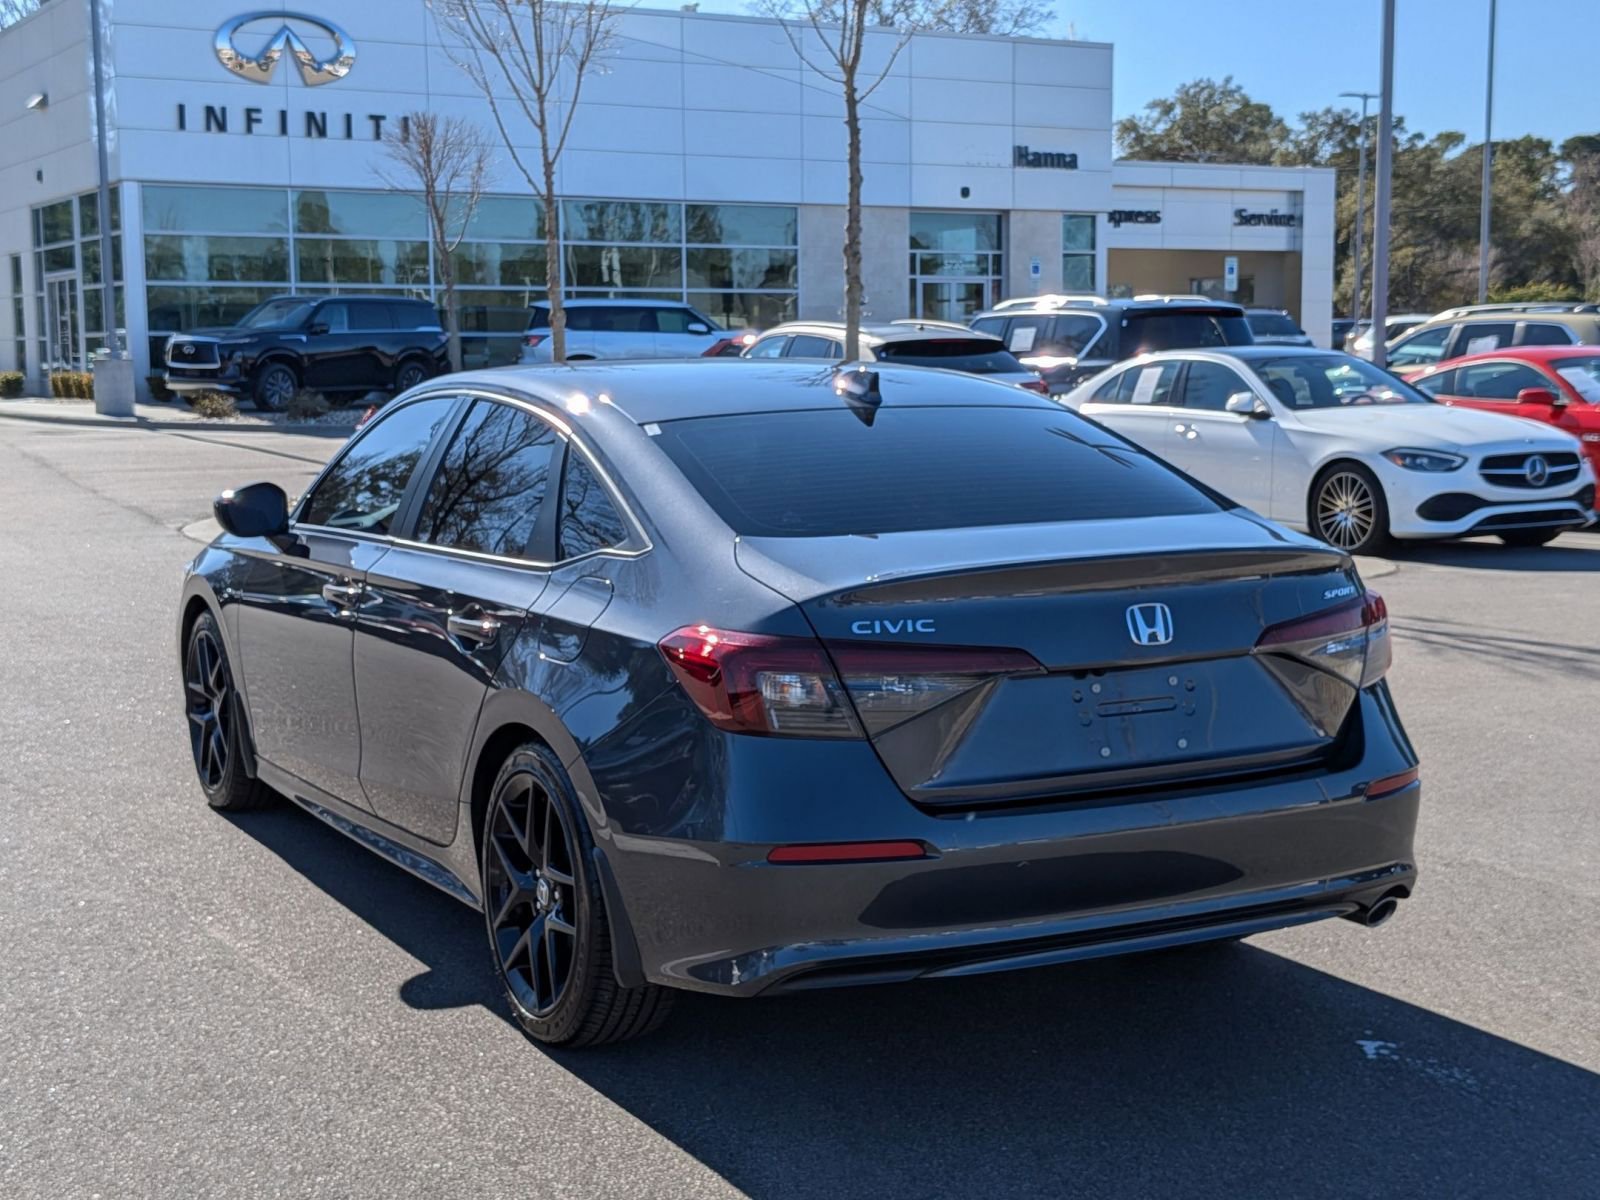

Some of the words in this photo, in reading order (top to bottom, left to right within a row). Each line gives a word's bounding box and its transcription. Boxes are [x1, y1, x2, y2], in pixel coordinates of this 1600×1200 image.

[177, 103, 410, 142] INFINITI
[1013, 145, 1077, 169] Hanna
[1233, 209, 1296, 227] Service
[1323, 586, 1355, 599] SPORT
[851, 619, 936, 634] CIVIC
